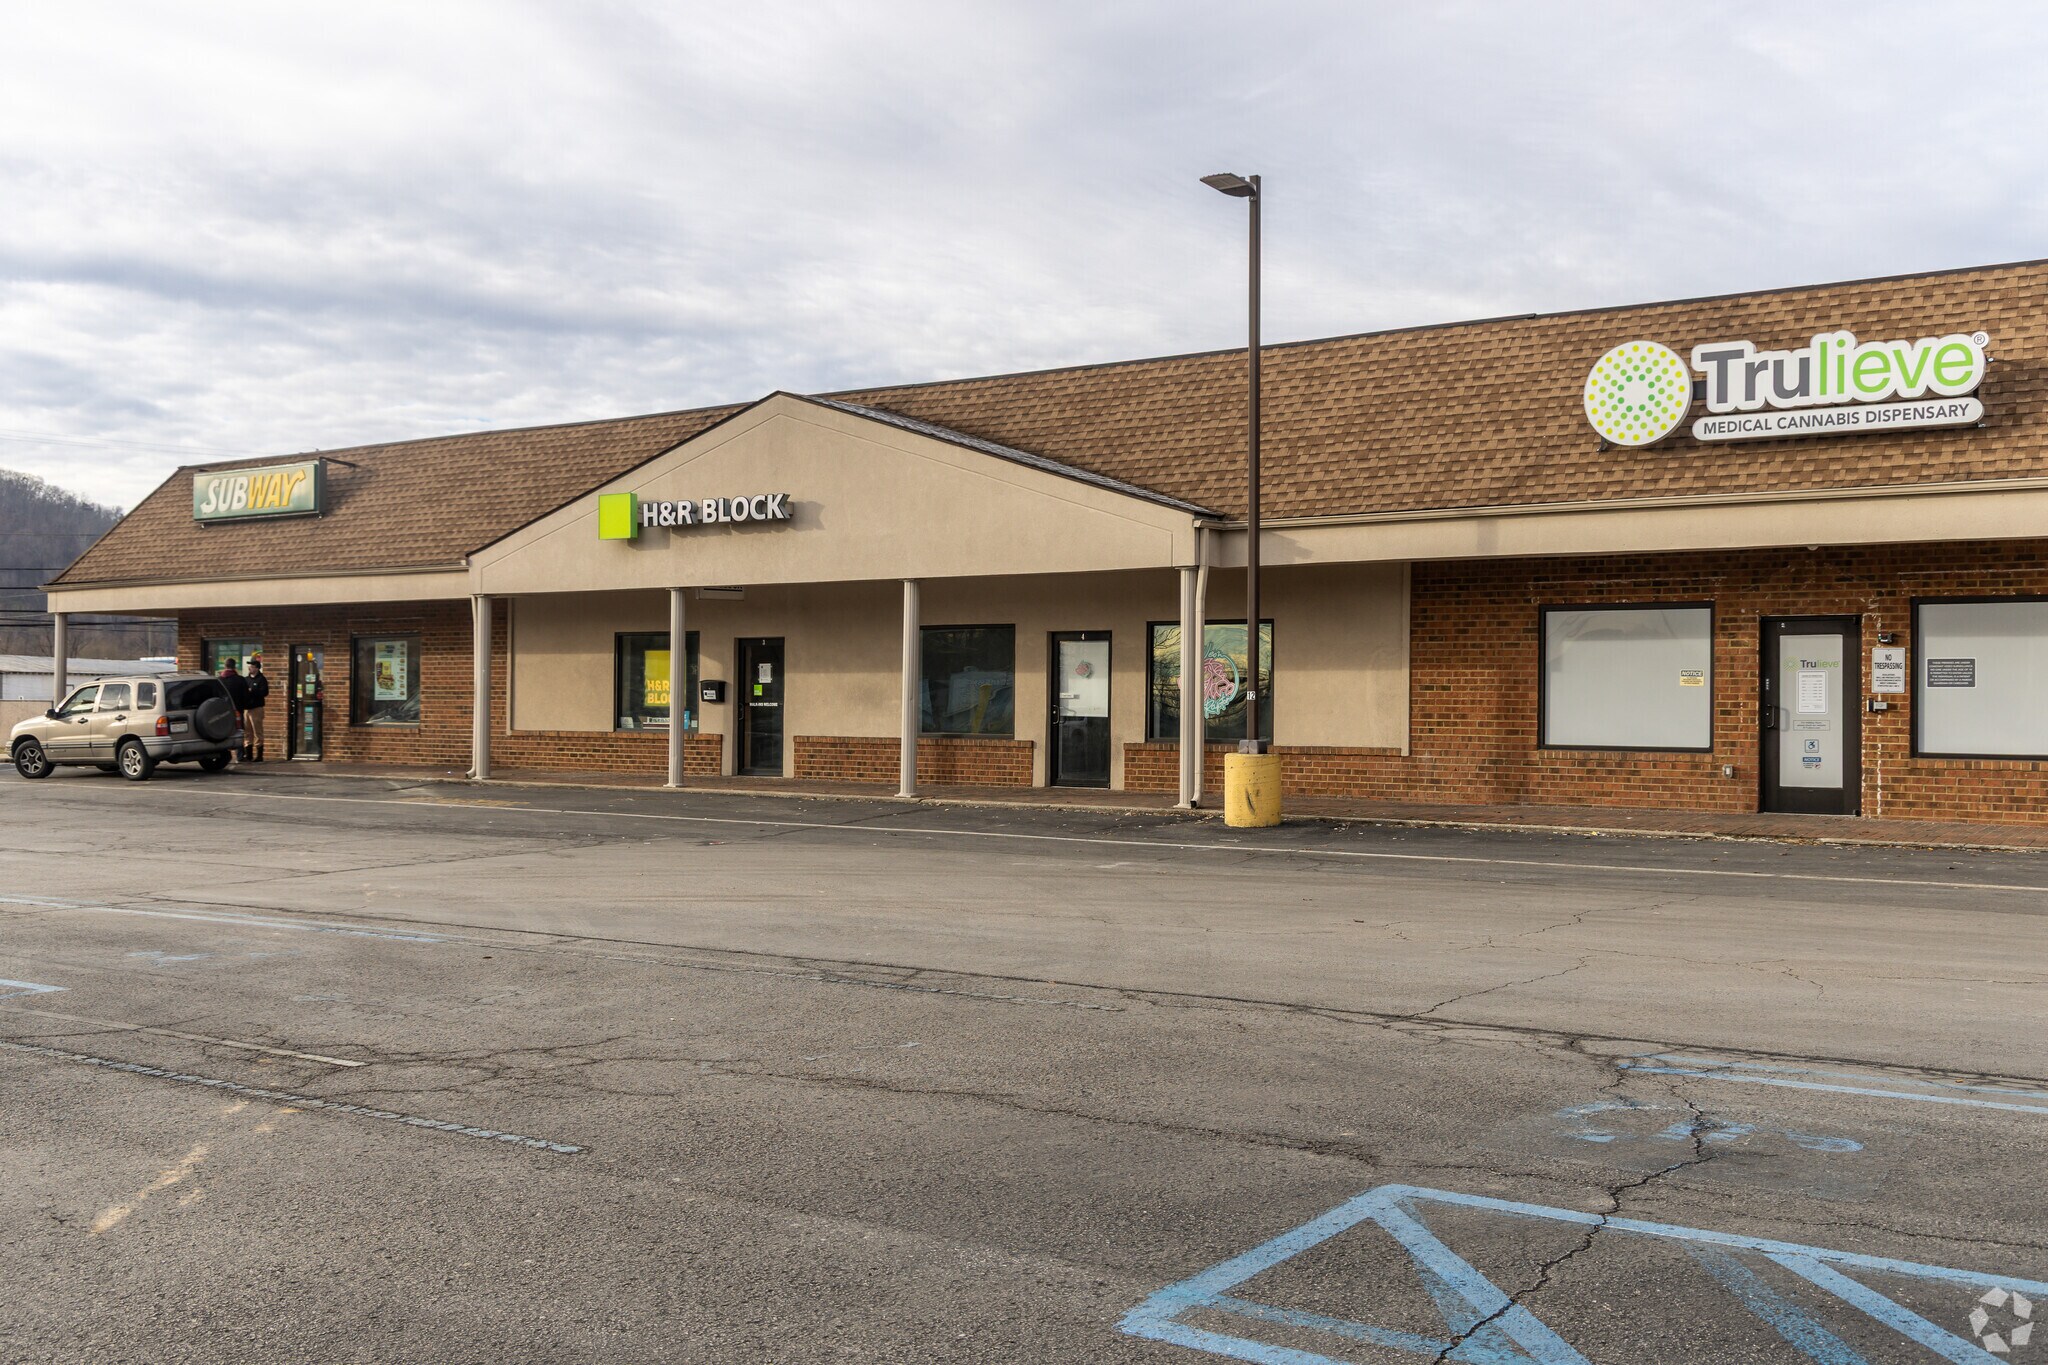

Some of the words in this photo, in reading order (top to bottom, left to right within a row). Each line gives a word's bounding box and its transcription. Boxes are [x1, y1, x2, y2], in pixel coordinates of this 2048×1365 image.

[1703, 417, 1772, 435] MEDICAL
[1777, 412, 1860, 430] CANNABIS
[1865, 403, 1970, 424] DISPENSARY
[200, 469, 306, 514] SUBWAY
[643, 501, 694, 527] H&R
[702, 493, 788, 525] BLOCK
[1800, 659, 1840, 668] Trulieve
[1874, 662, 1903, 670] TRESPASSING
[647, 680, 670, 691] H&R
[647, 692, 670, 704] BLO
